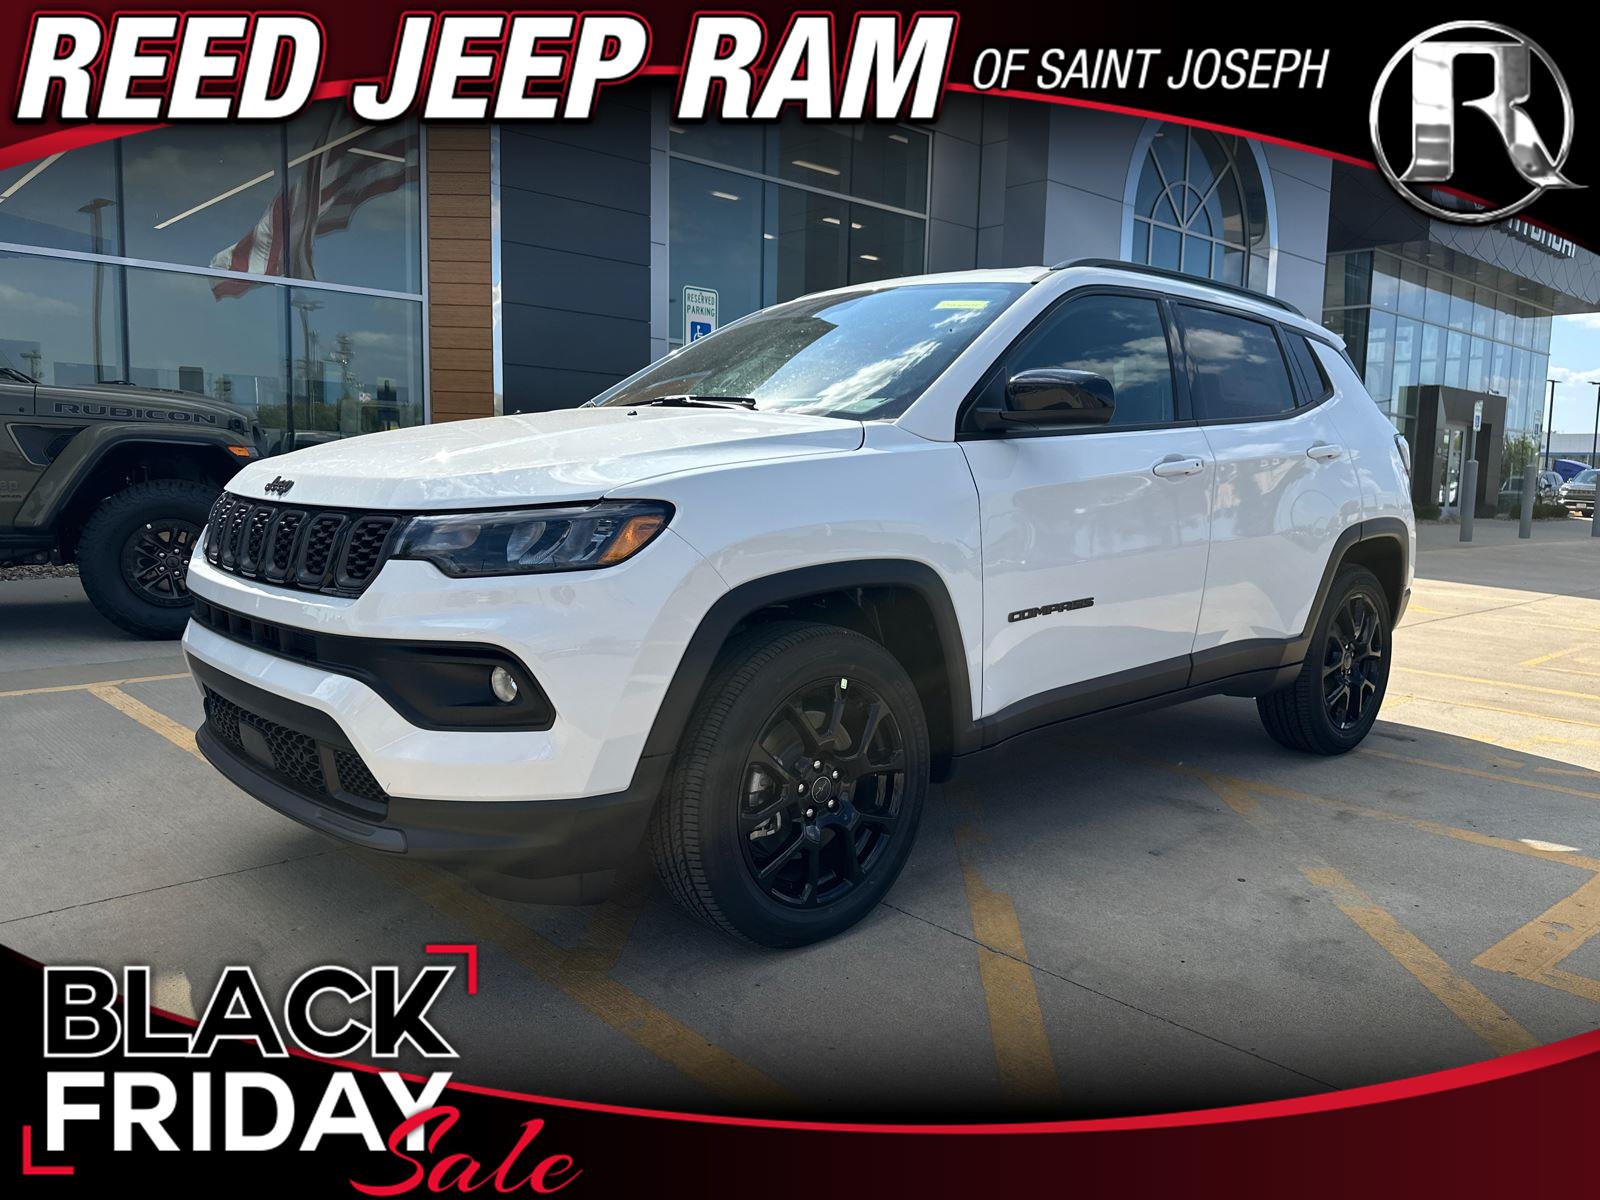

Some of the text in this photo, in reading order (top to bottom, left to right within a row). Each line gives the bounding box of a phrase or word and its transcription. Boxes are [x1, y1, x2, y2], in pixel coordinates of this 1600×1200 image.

[687, 293, 715, 306] RESERVED
[686, 304, 716, 318] PARKING
[53, 402, 217, 425] RUBICON
[1007, 596, 1095, 623] COMPASS
